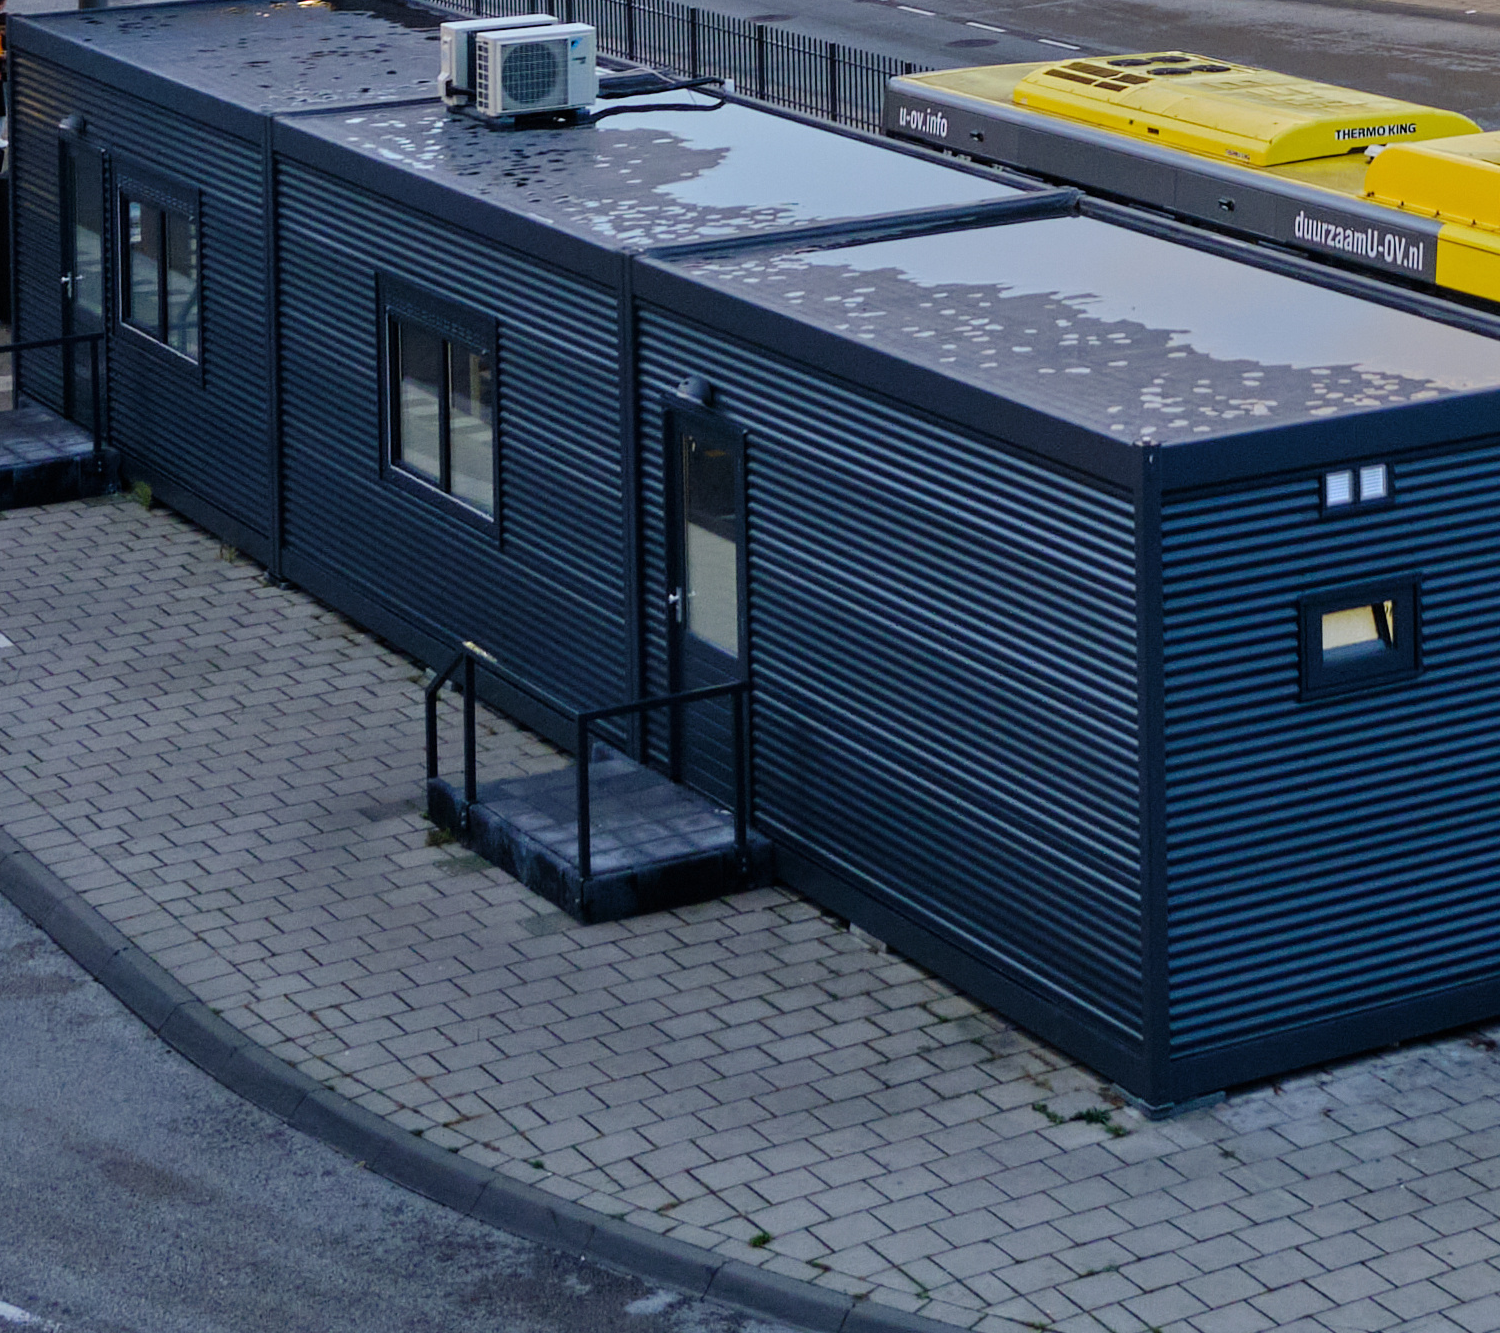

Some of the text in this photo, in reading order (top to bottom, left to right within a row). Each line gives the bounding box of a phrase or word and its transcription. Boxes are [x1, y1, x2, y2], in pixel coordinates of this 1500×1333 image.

[899, 106, 948, 138] u-ov.info
[1335, 123, 1417, 141] THERMO KING
[1294, 210, 1424, 271] duurzaamU-OV.nl
